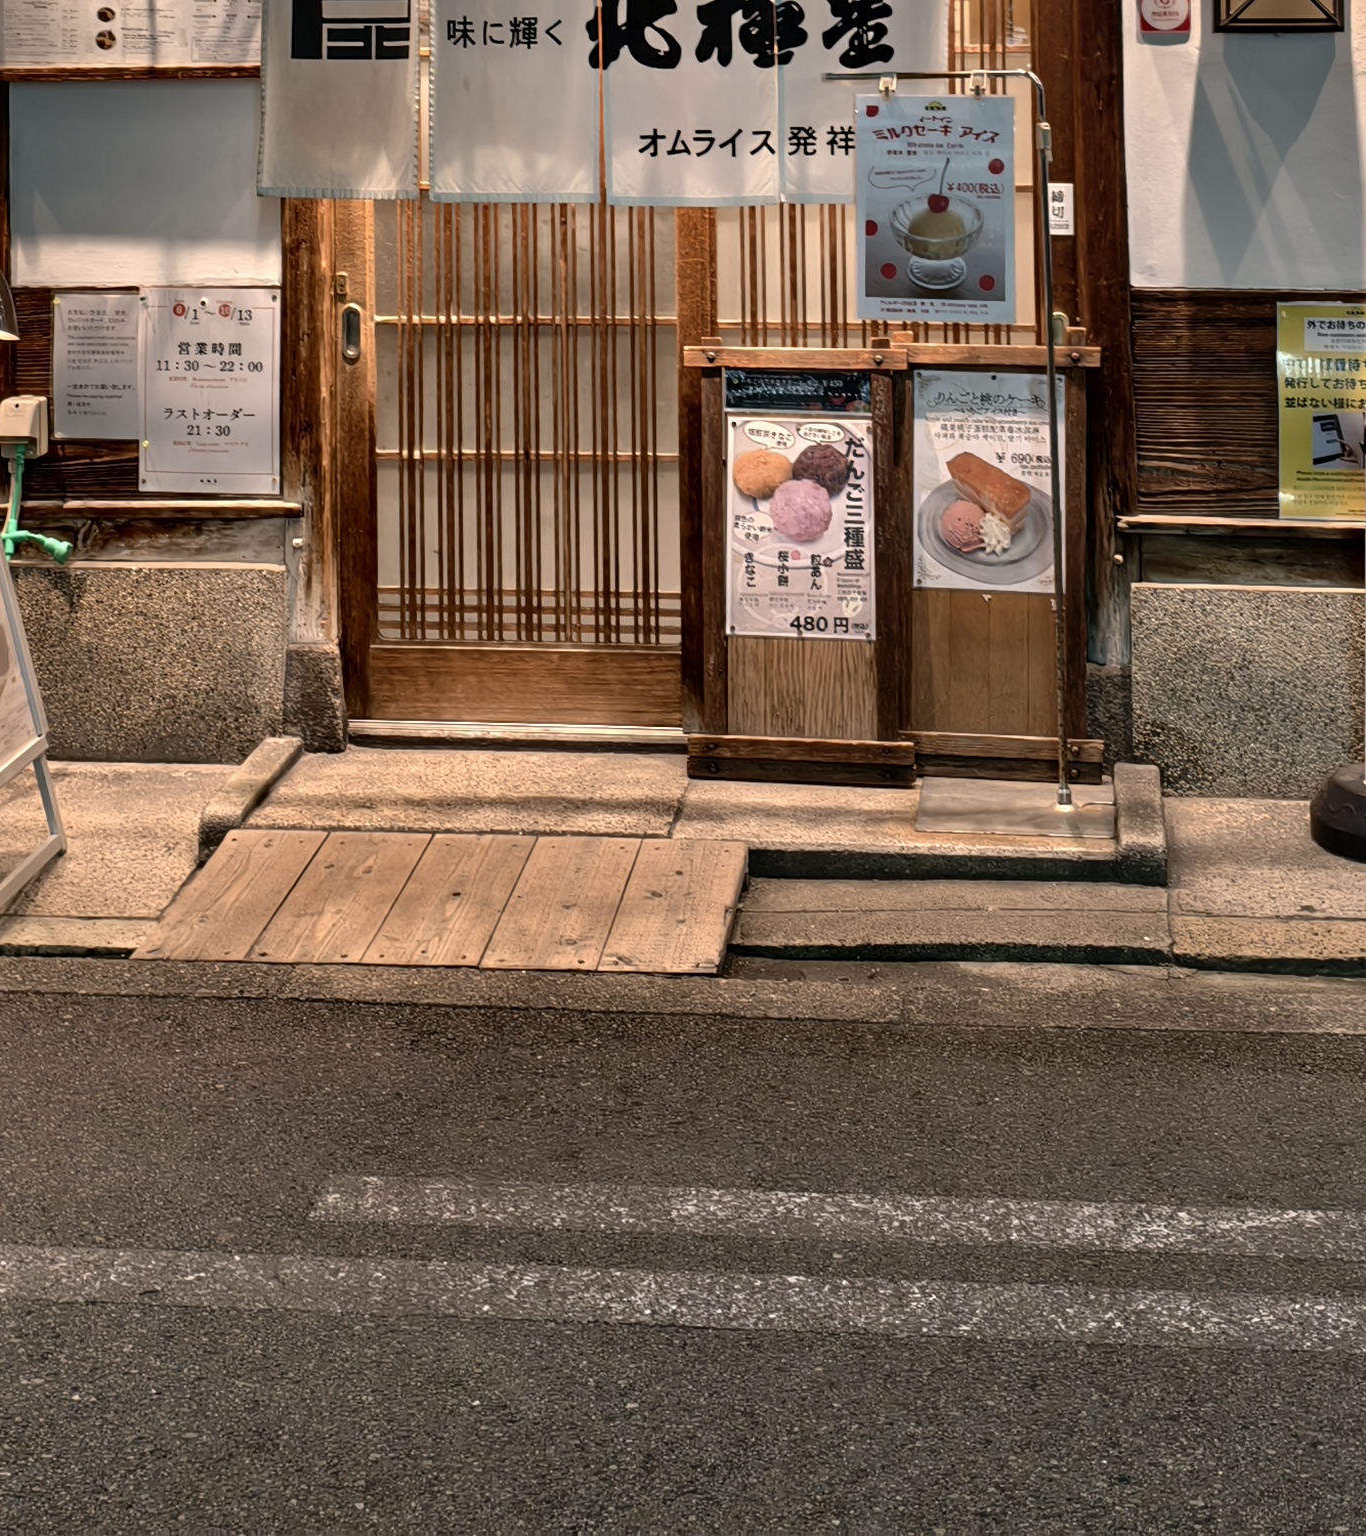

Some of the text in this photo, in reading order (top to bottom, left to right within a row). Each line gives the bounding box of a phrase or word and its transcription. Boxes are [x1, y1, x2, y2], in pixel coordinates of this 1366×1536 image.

[446, 16, 565, 50] 味に輝く
[872, 125, 1000, 144] ミルクセーキ アイス
[177, 341, 243, 356] 営業時間
[163, 407, 256, 421] ラストオーダー
[844, 437, 866, 571] だんご三種盛
